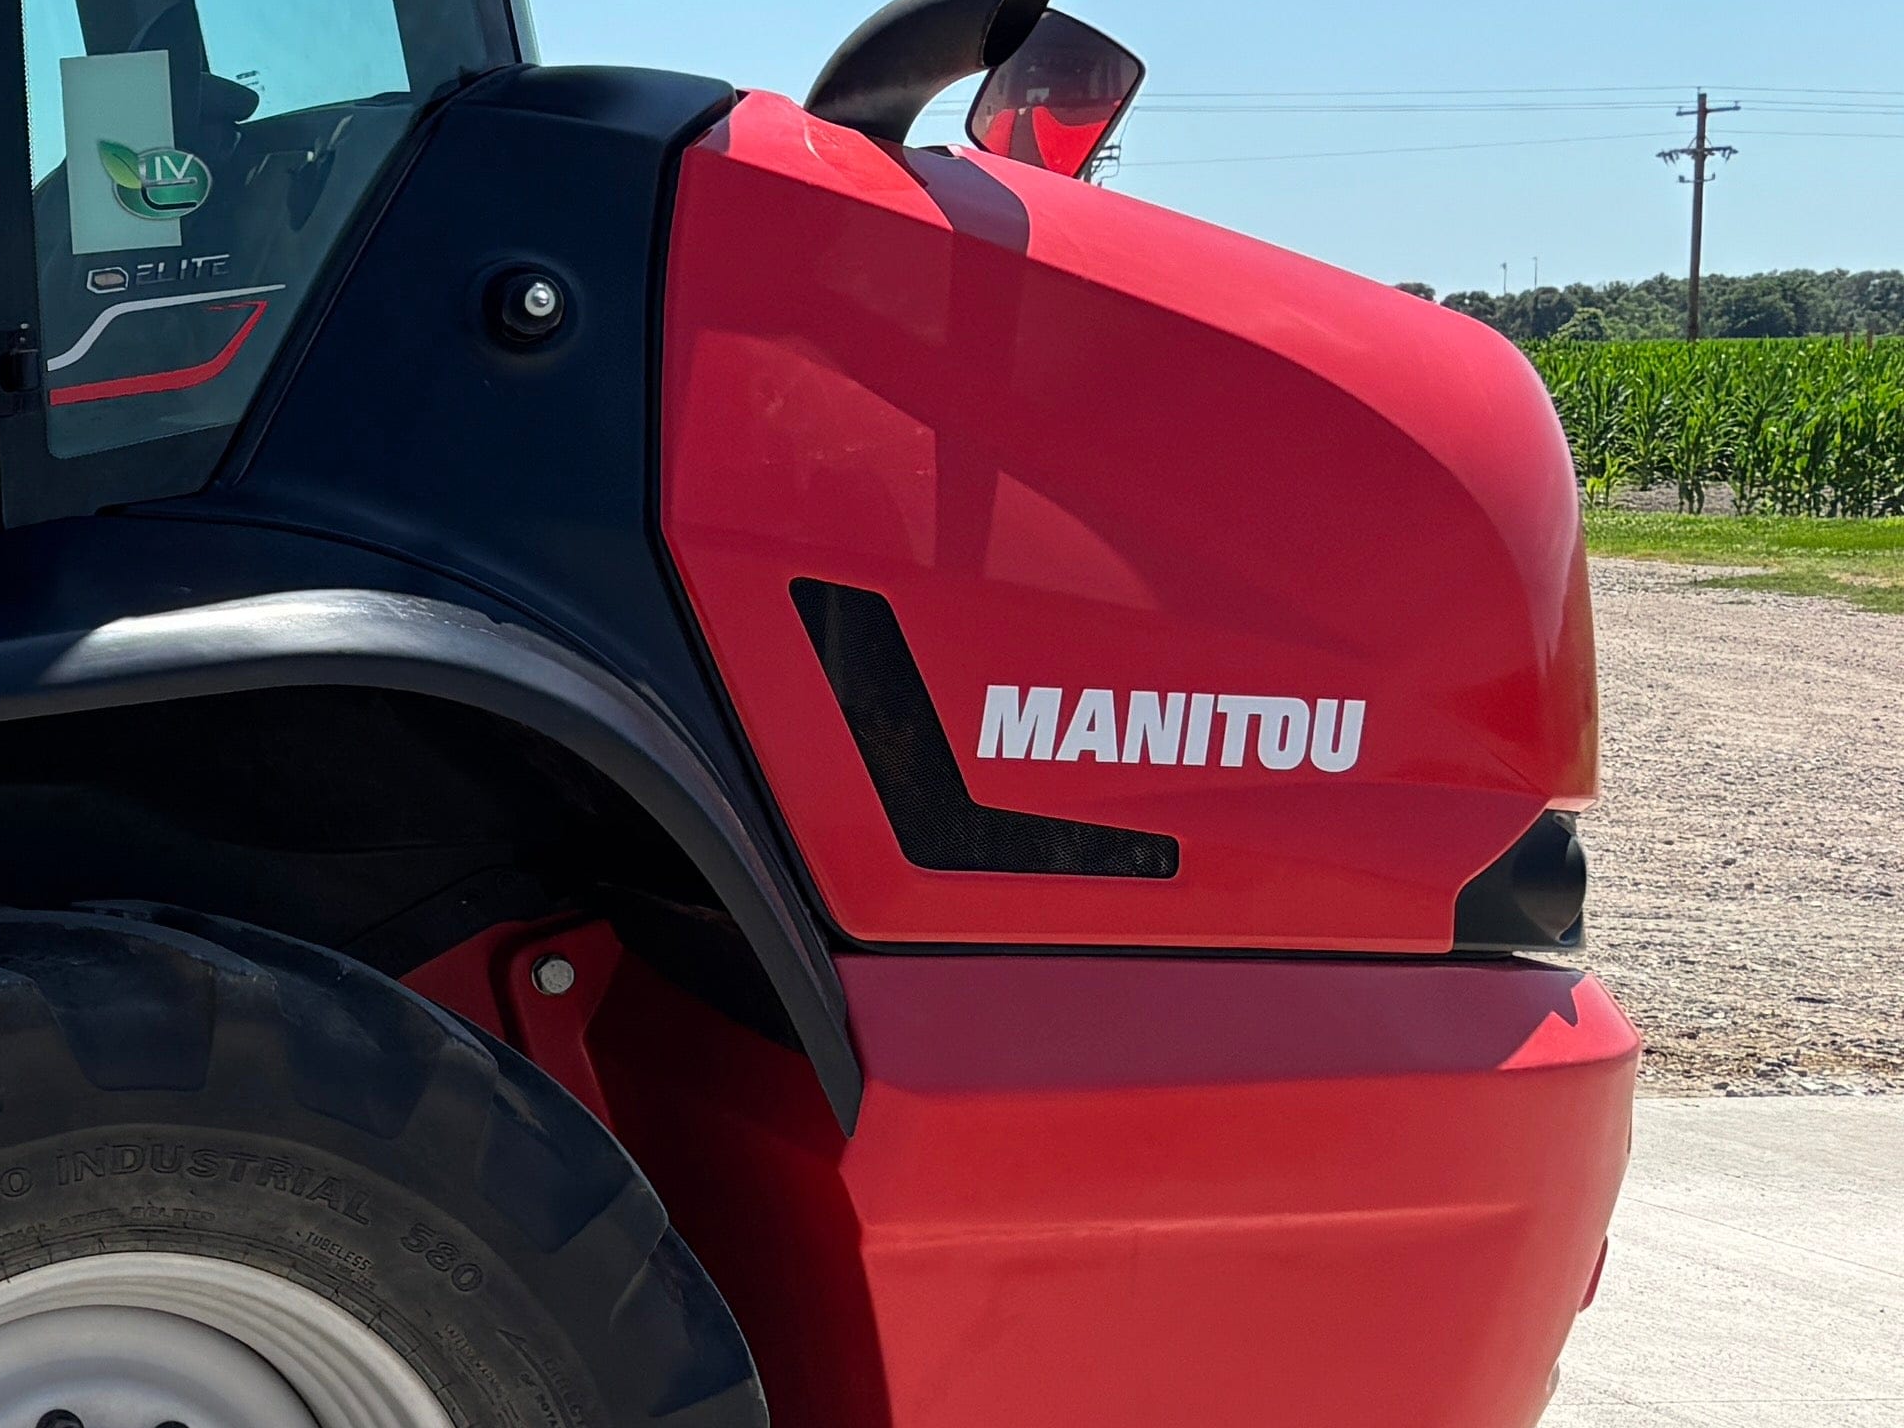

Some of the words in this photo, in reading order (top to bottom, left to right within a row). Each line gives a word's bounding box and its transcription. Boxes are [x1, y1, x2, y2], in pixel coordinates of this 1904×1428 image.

[136, 254, 230, 285] ELITE
[976, 684, 1366, 772] MANITOU
[55, 1142, 376, 1227] INDUSTRIAL
[400, 1220, 484, 1294] 580
[305, 1229, 372, 1272] TUBELESS
